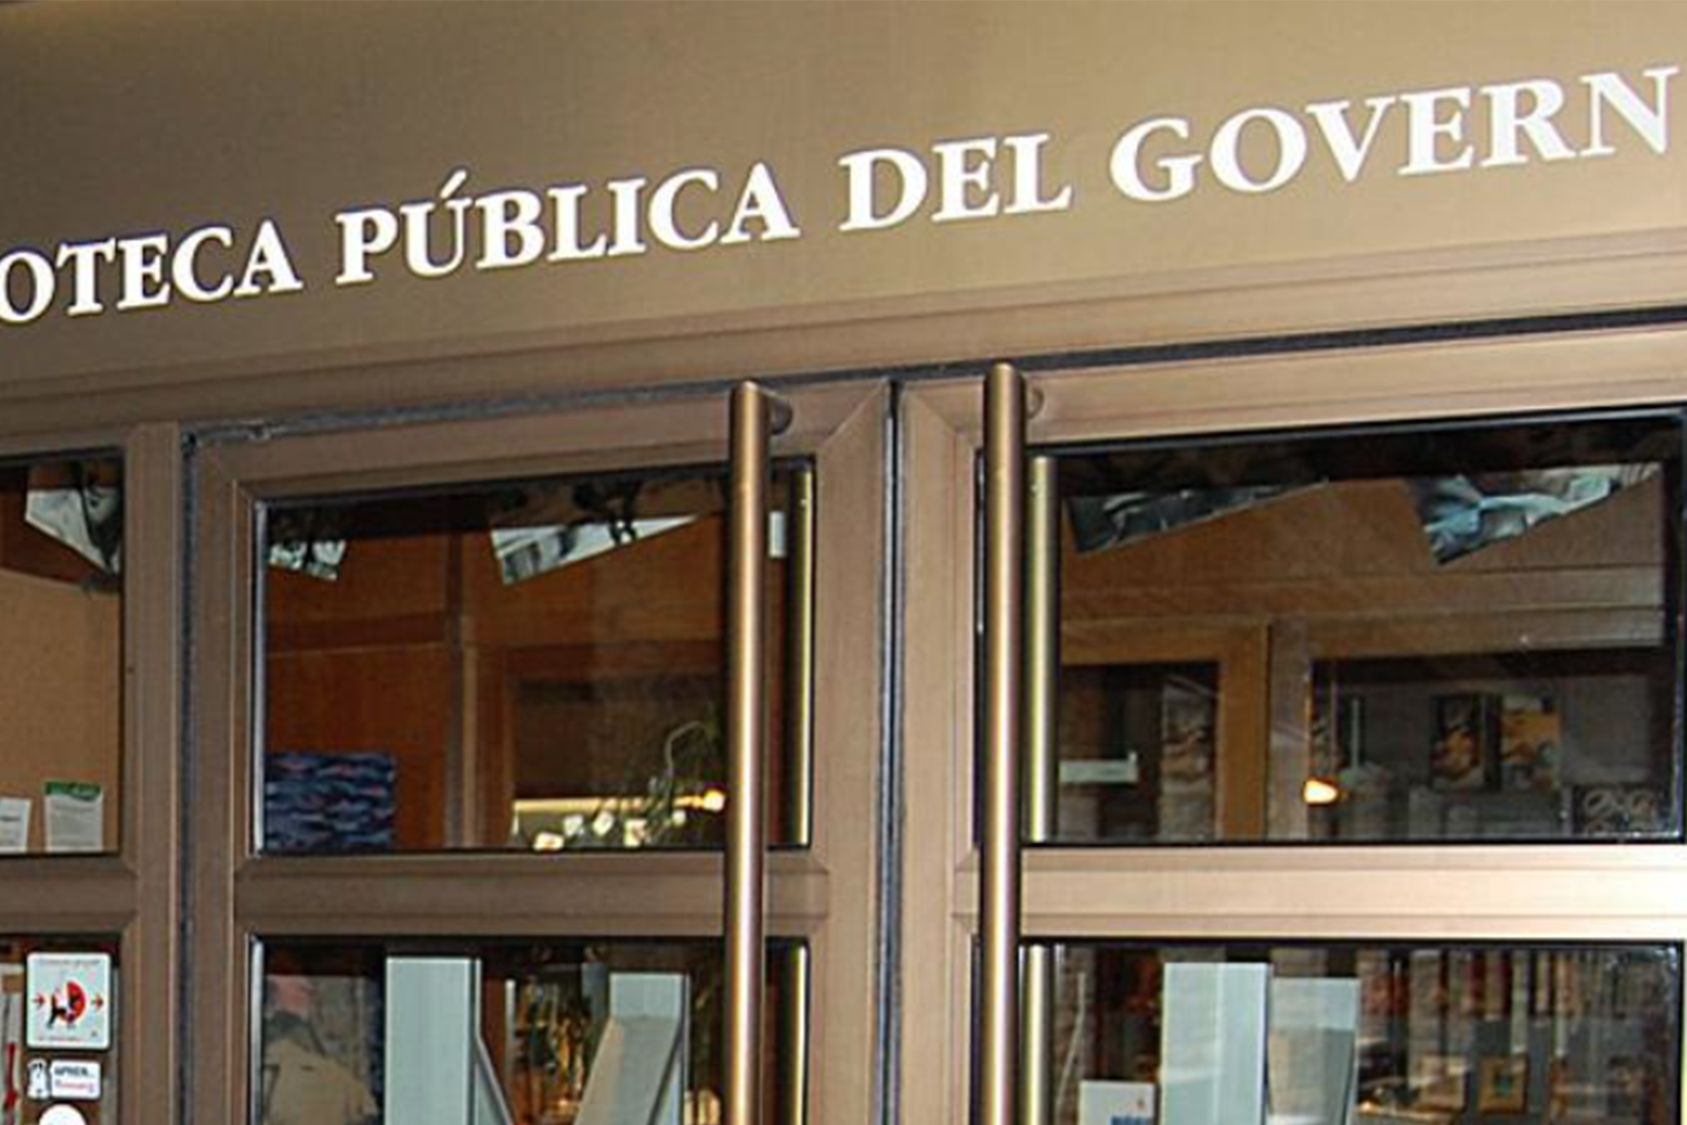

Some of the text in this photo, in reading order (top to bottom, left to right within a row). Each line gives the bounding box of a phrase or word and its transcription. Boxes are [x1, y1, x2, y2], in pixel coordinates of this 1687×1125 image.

[335, 170, 800, 285] PÚBLICA
[839, 133, 1073, 232] DEL
[1110, 65, 1680, 202] GOVERN
